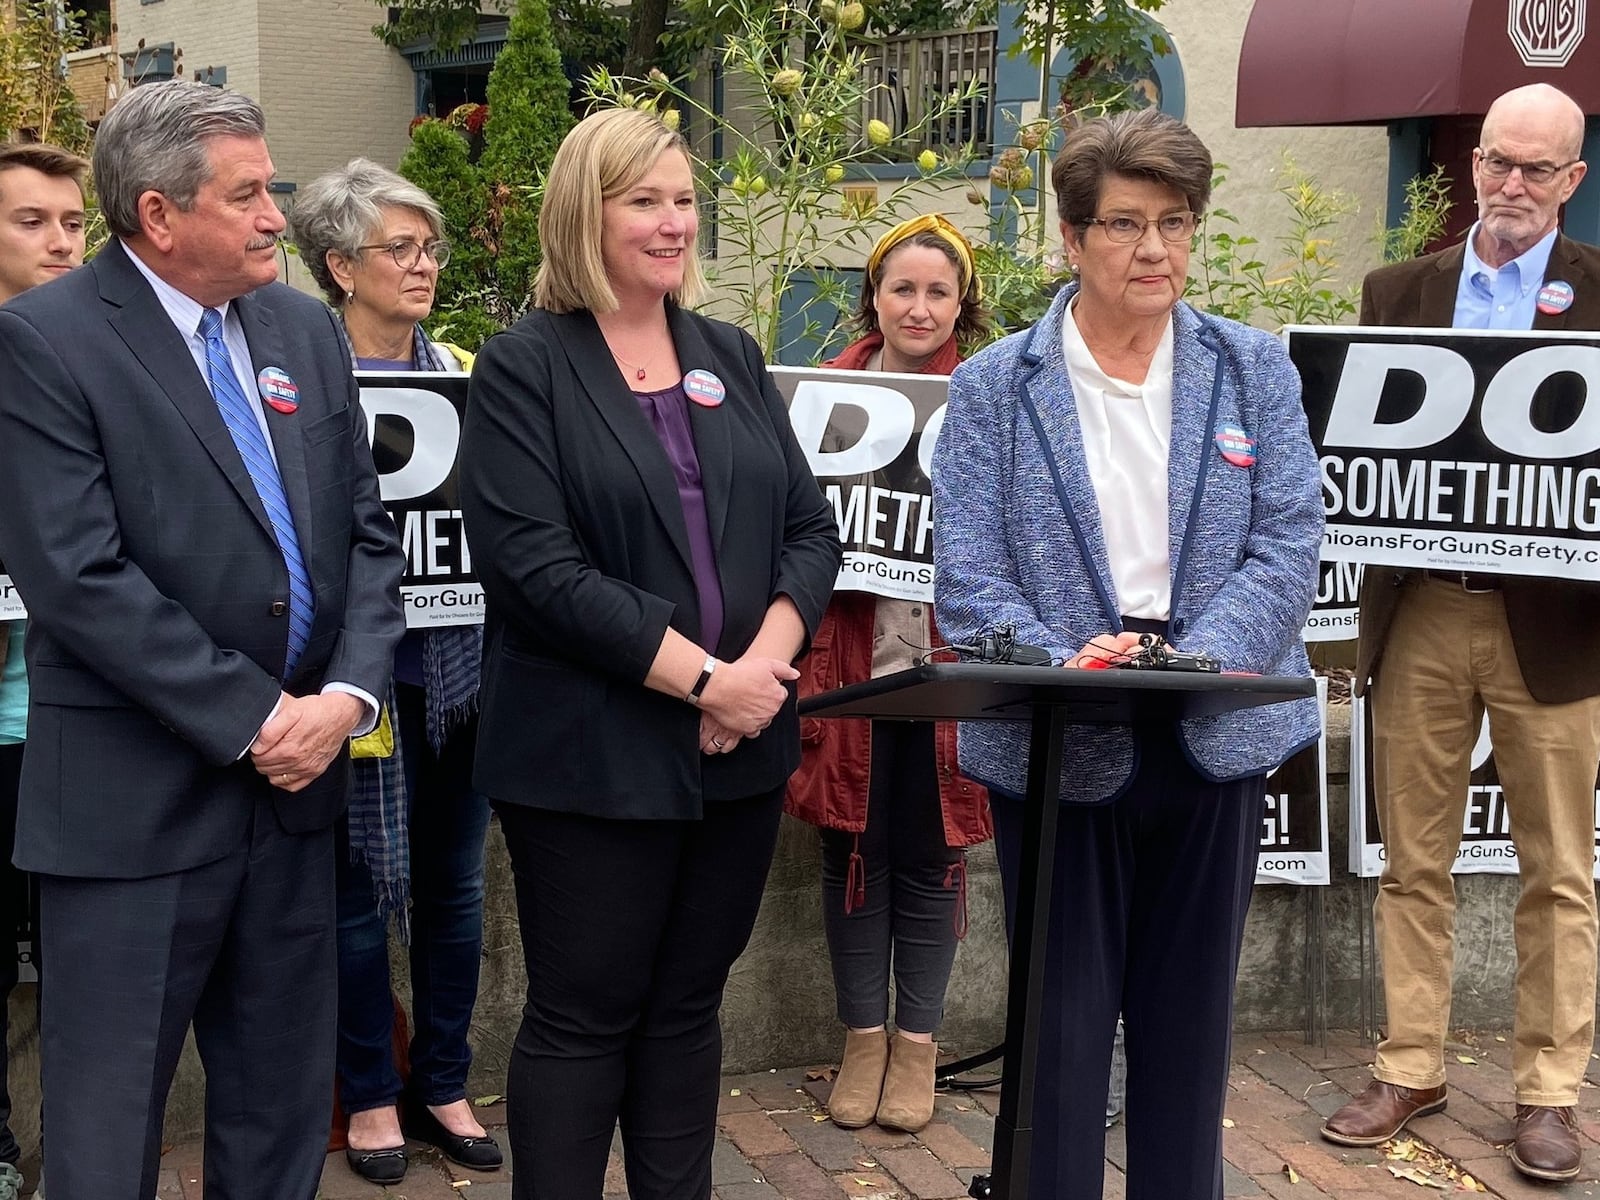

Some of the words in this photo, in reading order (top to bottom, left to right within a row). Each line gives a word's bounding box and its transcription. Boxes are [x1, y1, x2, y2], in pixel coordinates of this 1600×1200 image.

[1322, 342, 1600, 459] DO
[1319, 455, 1600, 532] SOMETHING
[841, 557, 936, 585] ForGunS
[402, 590, 486, 608] ForGun
